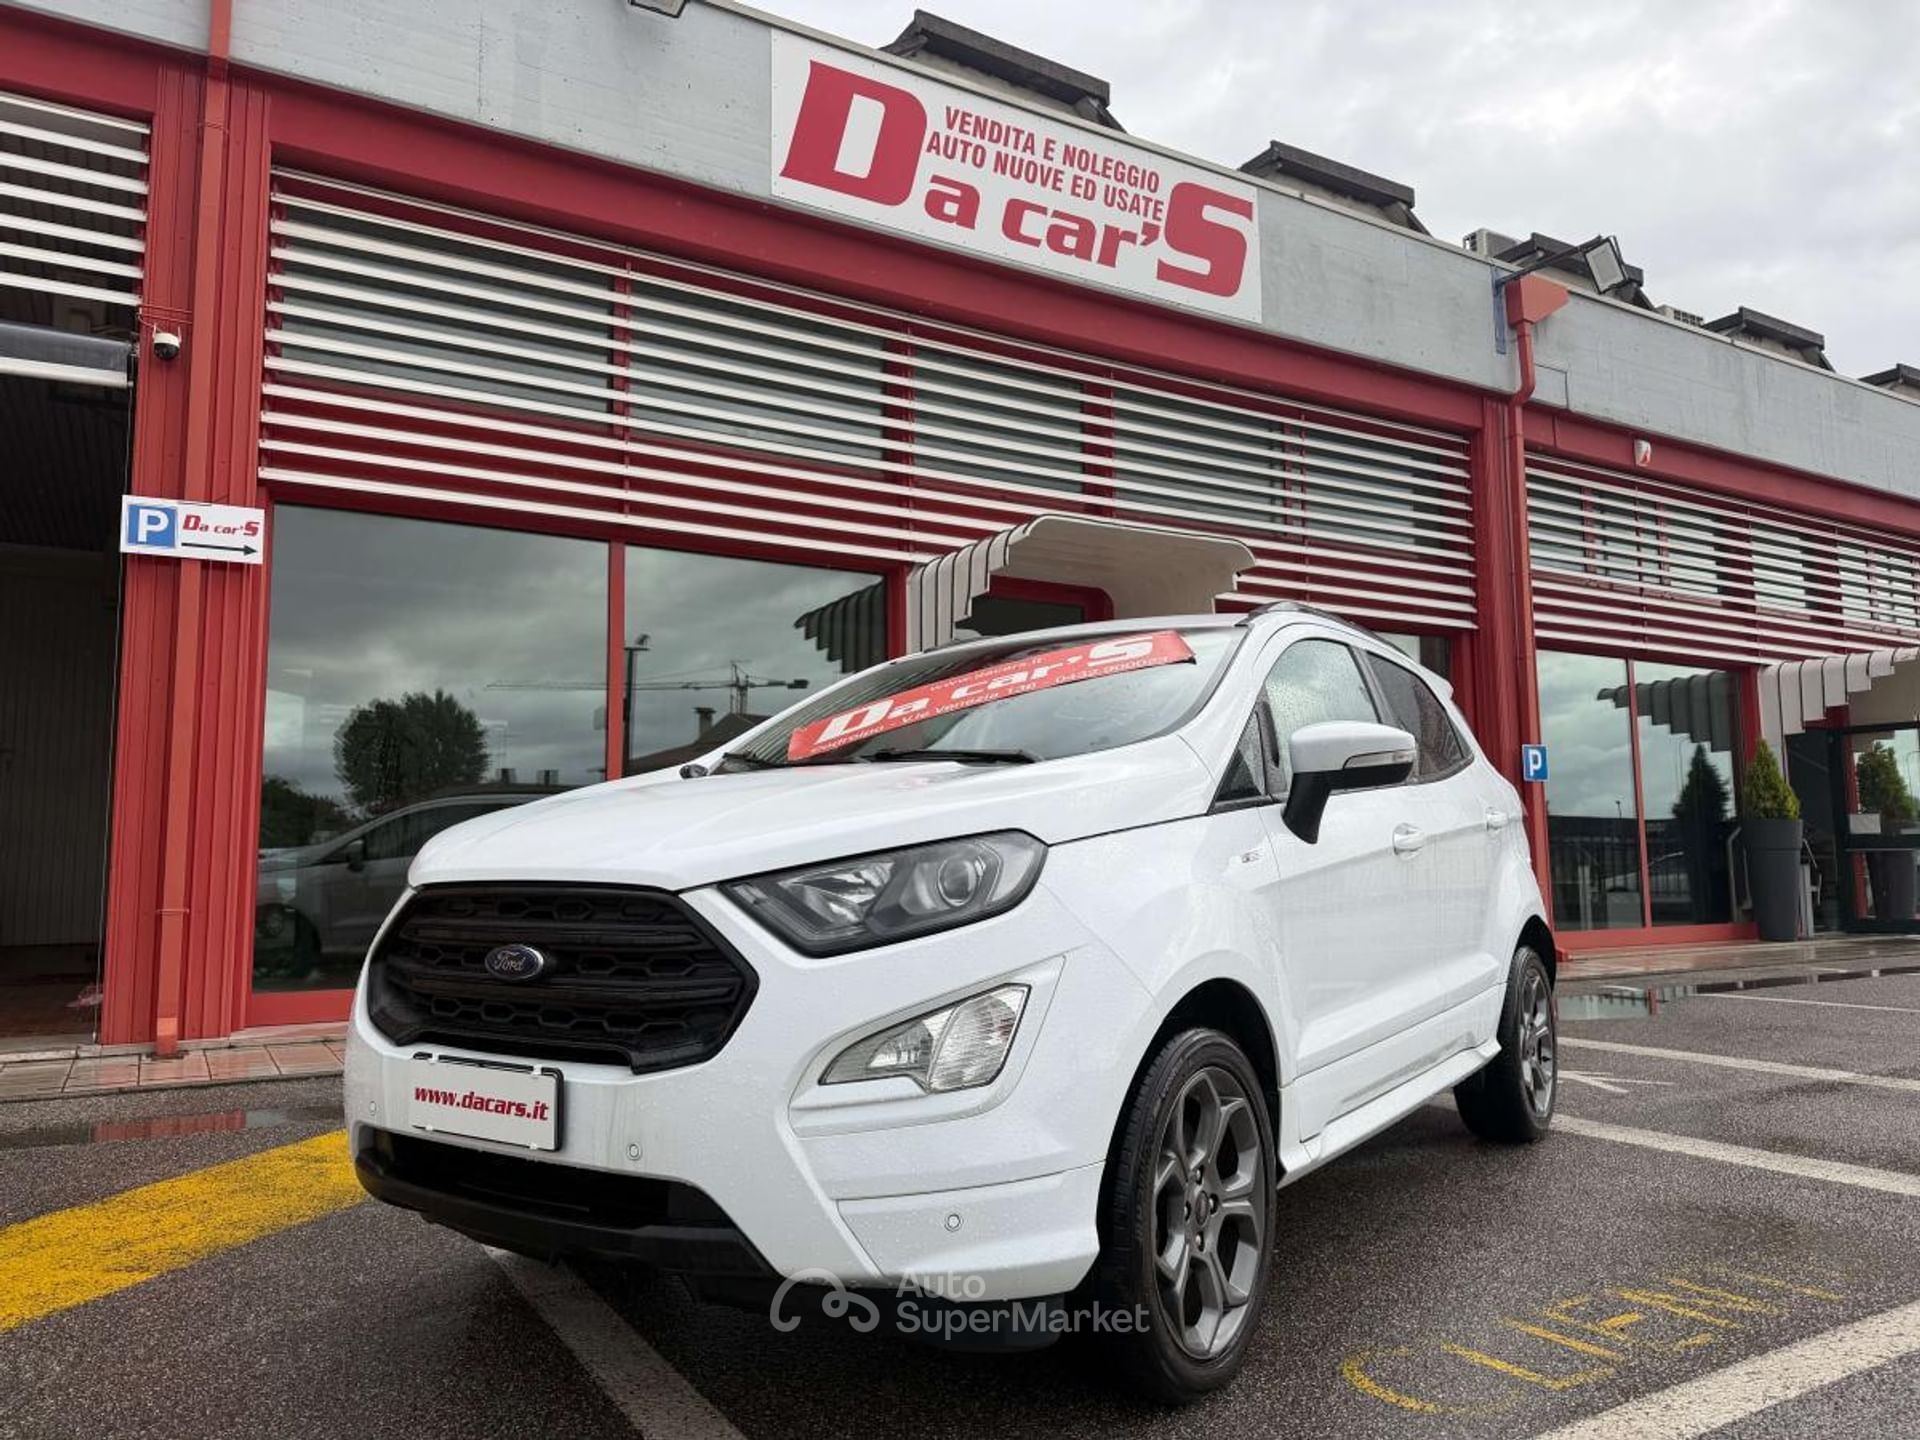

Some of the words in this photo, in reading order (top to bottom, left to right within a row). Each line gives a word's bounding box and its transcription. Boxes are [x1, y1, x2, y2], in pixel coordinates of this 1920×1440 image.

[945, 105, 1037, 154] VENDITA
[1043, 138, 1056, 159] E
[1063, 144, 1160, 194] NOLEGGIO
[779, 59, 980, 230] Da
[1002, 181, 1253, 298] car'S
[926, 131, 985, 169] AUTO
[993, 150, 1064, 192] NUOVE
[1070, 172, 1097, 201] ED
[1103, 182, 1164, 222] USATE
[137, 509, 169, 543] P
[182, 514, 209, 532] Da
[813, 697, 929, 746] Da
[1529, 750, 1542, 777] P
[495, 950, 526, 972] Ford
[414, 1087, 549, 1121] www.dacars.it
